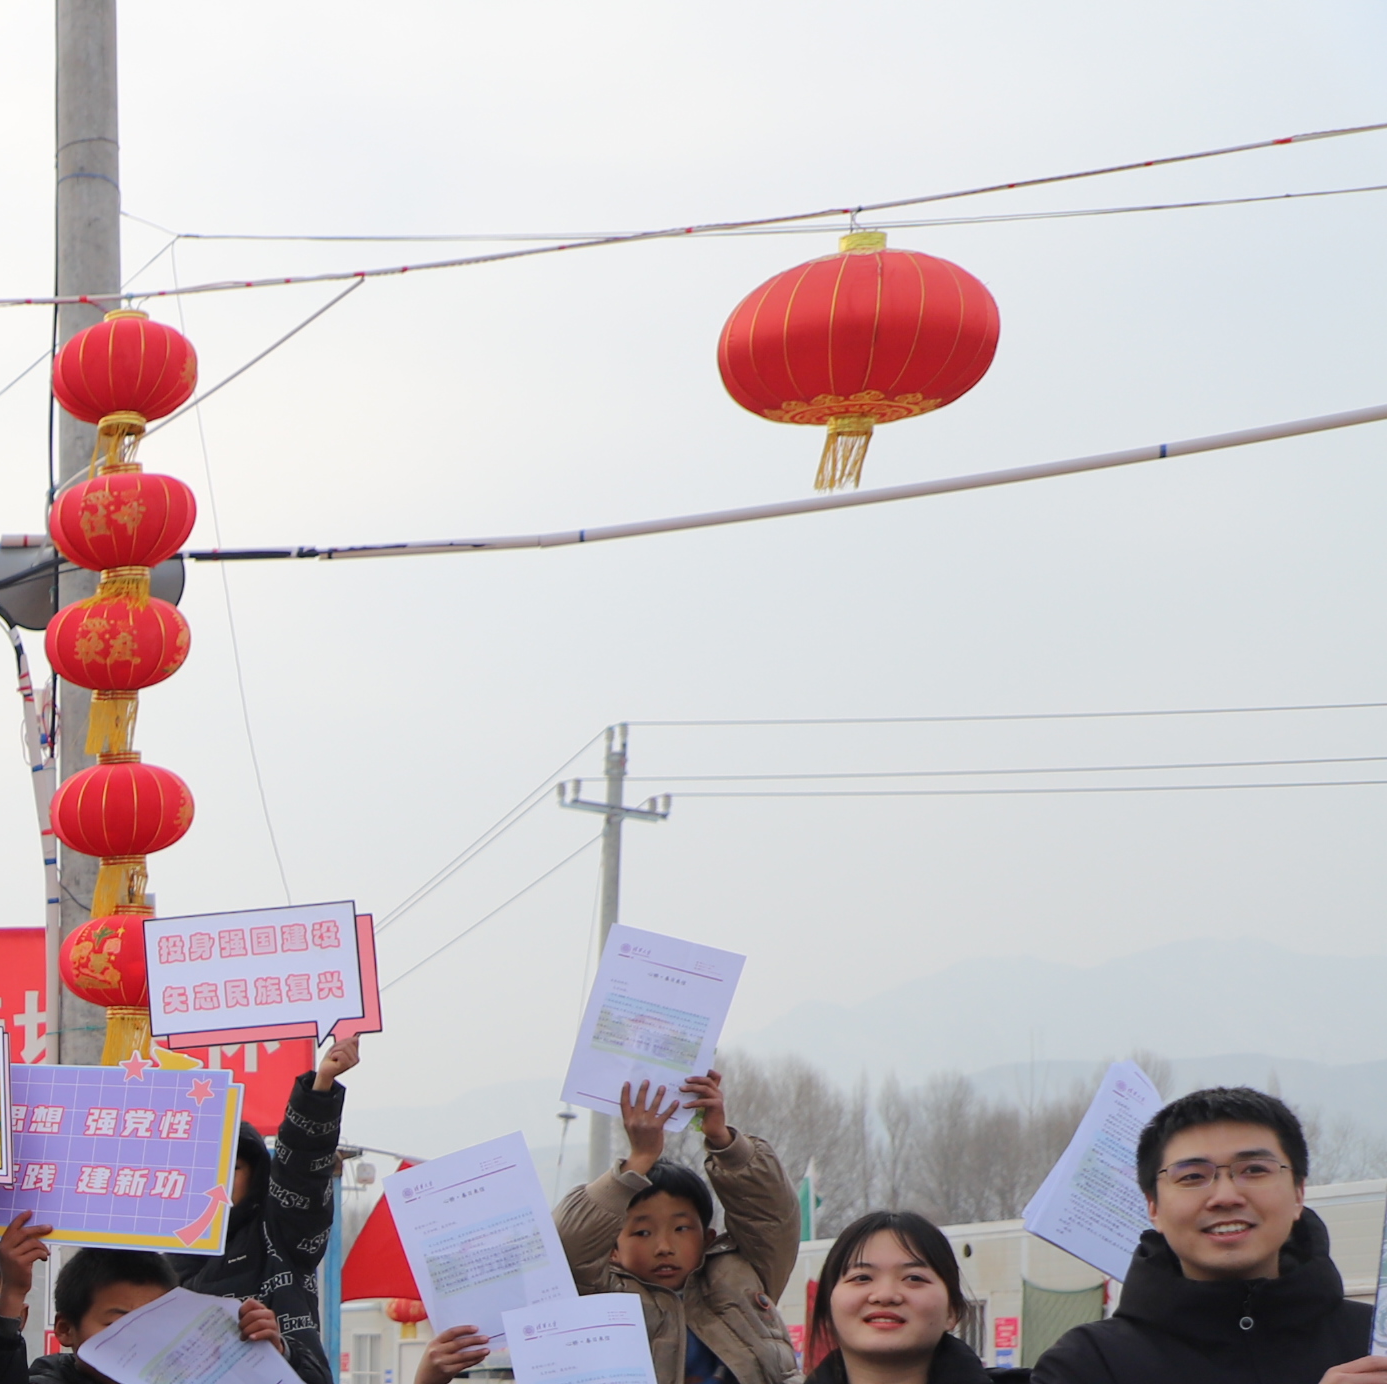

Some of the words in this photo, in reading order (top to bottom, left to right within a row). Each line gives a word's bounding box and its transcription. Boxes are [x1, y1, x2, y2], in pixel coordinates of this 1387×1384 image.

[157, 920, 341, 964] 投身强国建设
[162, 971, 345, 1014] 矢志民族复兴
[84, 1108, 193, 1139] 强党性
[76, 1165, 187, 1199] 建新功
